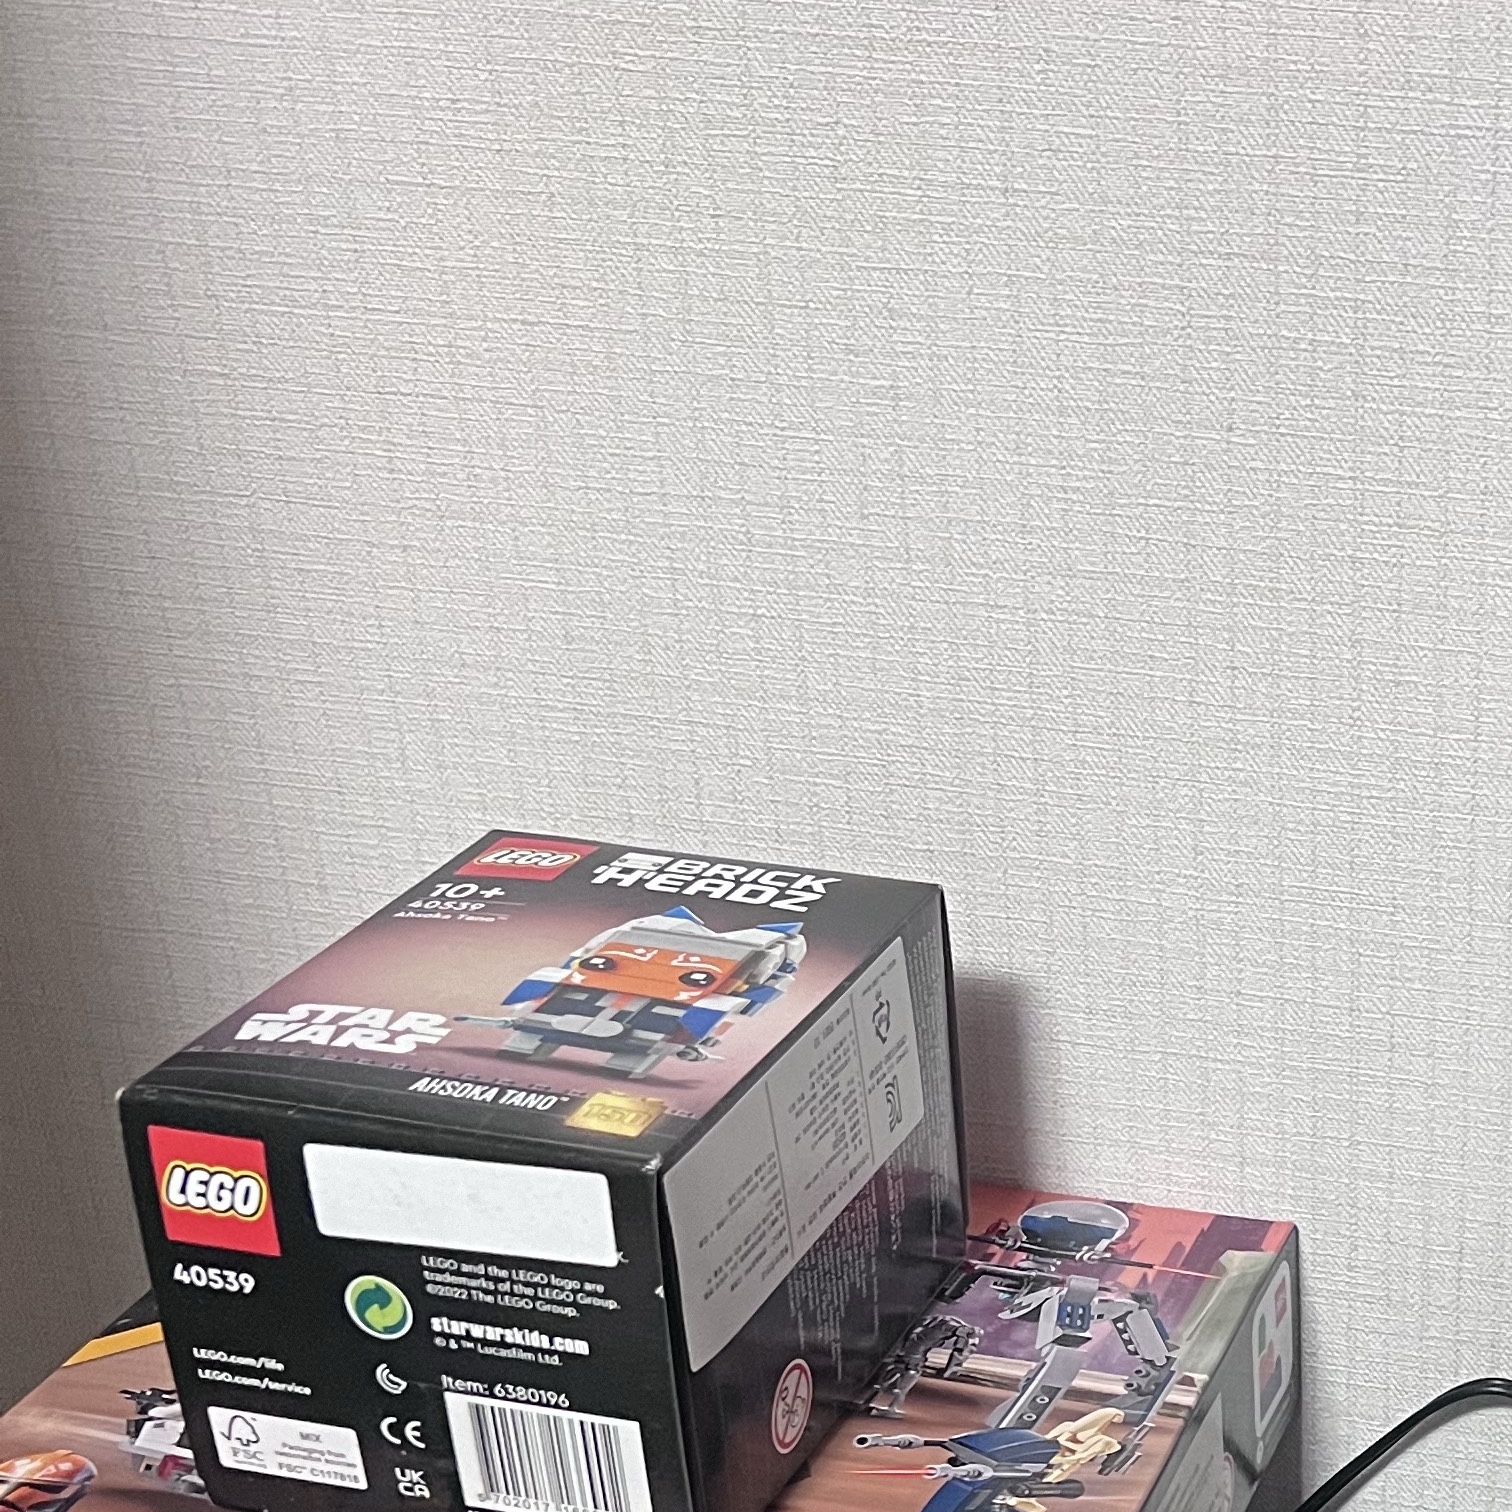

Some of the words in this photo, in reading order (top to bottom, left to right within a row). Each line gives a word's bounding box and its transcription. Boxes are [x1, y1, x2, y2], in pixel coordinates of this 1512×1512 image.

[478, 849, 575, 867] LEGO
[664, 858, 842, 894] BRICK
[429, 883, 505, 899] 10+
[407, 900, 486, 911] 40539
[251, 1003, 452, 1037] STAR
[233, 1020, 451, 1054] WARS
[409, 1076, 499, 1103] AHSOKA
[167, 1164, 262, 1217] LEGO
[173, 1262, 256, 1294] 40539
[421, 1255, 458, 1271] LEGO
[460, 1263, 485, 1275] and
[487, 1265, 509, 1279] the
[511, 1269, 548, 1285] LEGO
[550, 1274, 581, 1291] logo
[583, 1281, 605, 1294] are
[423, 1270, 496, 1291] trademarks
[497, 1280, 512, 1293] of
[513, 1283, 535, 1297] the
[537, 1286, 574, 1303] LEGO
[576, 1293, 621, 1311] Group.
[470, 1290, 495, 1304] The
[496, 1294, 533, 1310] LEGO
[535, 1300, 580, 1318] Group.
[430, 1316, 590, 1356] starwarskids.com
[193, 1347, 285, 1373] LEGO.com/life
[197, 1368, 312, 1396] LEGO.com/service
[441, 1374, 490, 1395] Item:
[493, 1383, 570, 1409] 6380196
[394, 1467, 427, 1485] UK
[398, 1482, 431, 1500] CA
[494, 1494, 550, 1512] 702017
